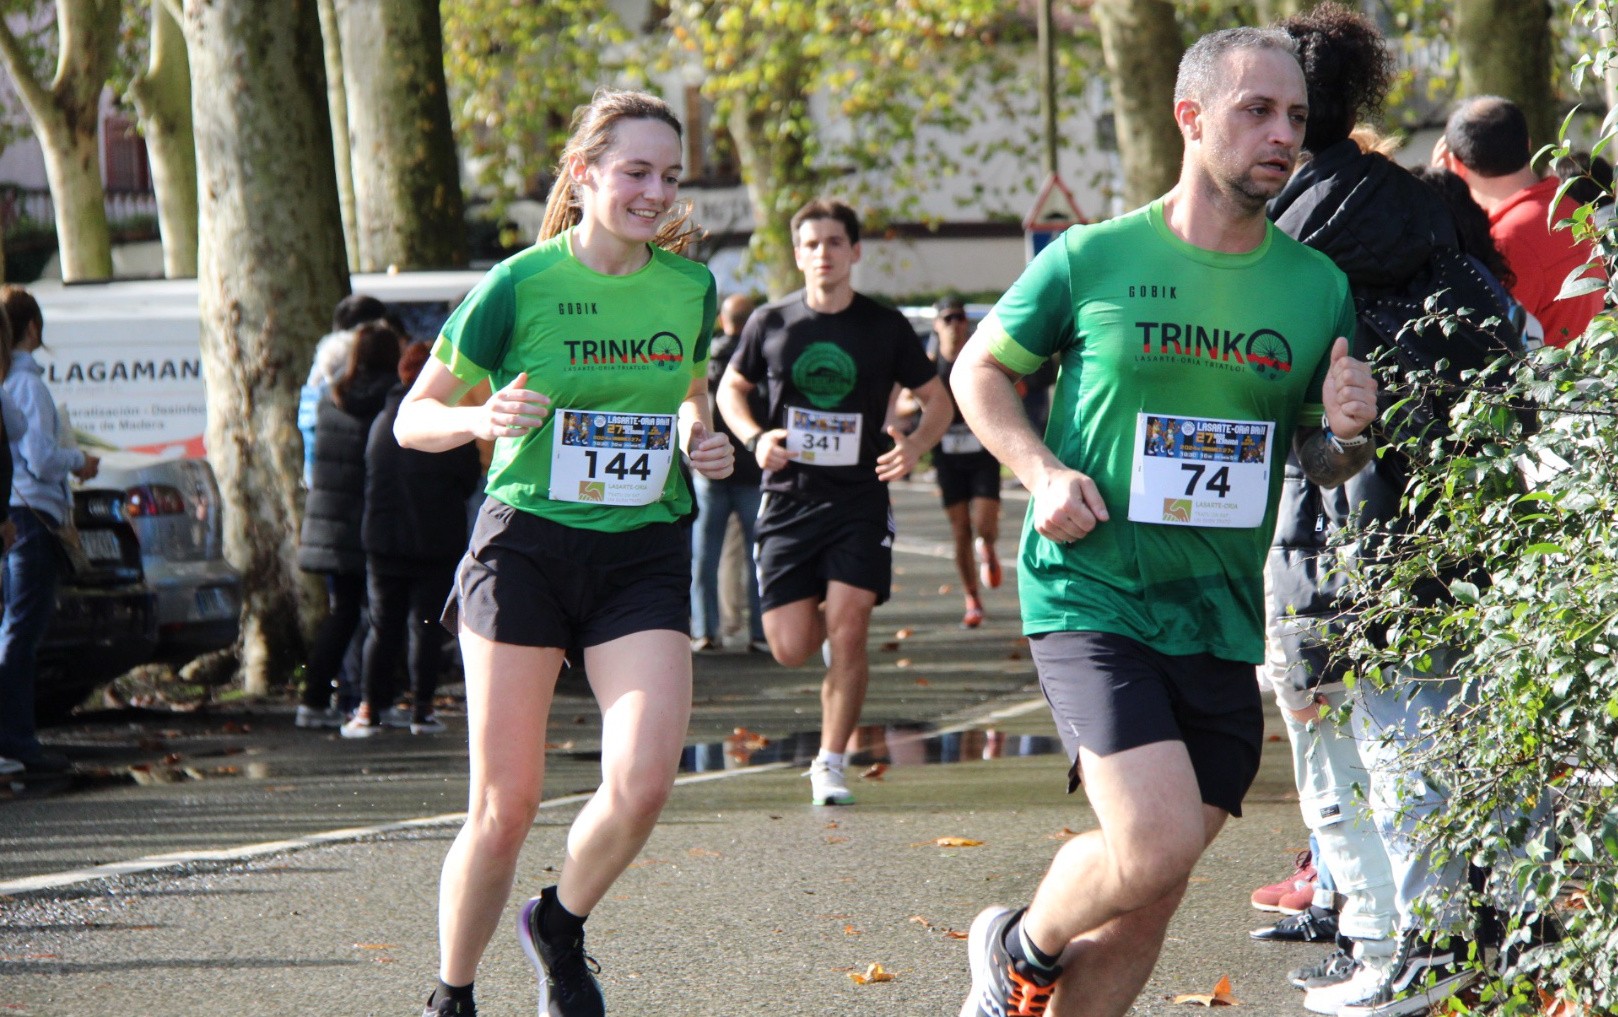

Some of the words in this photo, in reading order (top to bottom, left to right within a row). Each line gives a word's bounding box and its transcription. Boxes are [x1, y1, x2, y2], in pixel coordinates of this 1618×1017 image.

[1129, 285, 1177, 299] GOBIK
[558, 303, 598, 315] GOBIK
[39, 359, 200, 383] LAGAMAN
[803, 433, 840, 451] 341
[585, 450, 651, 481] 144
[1181, 463, 1231, 498] 74
